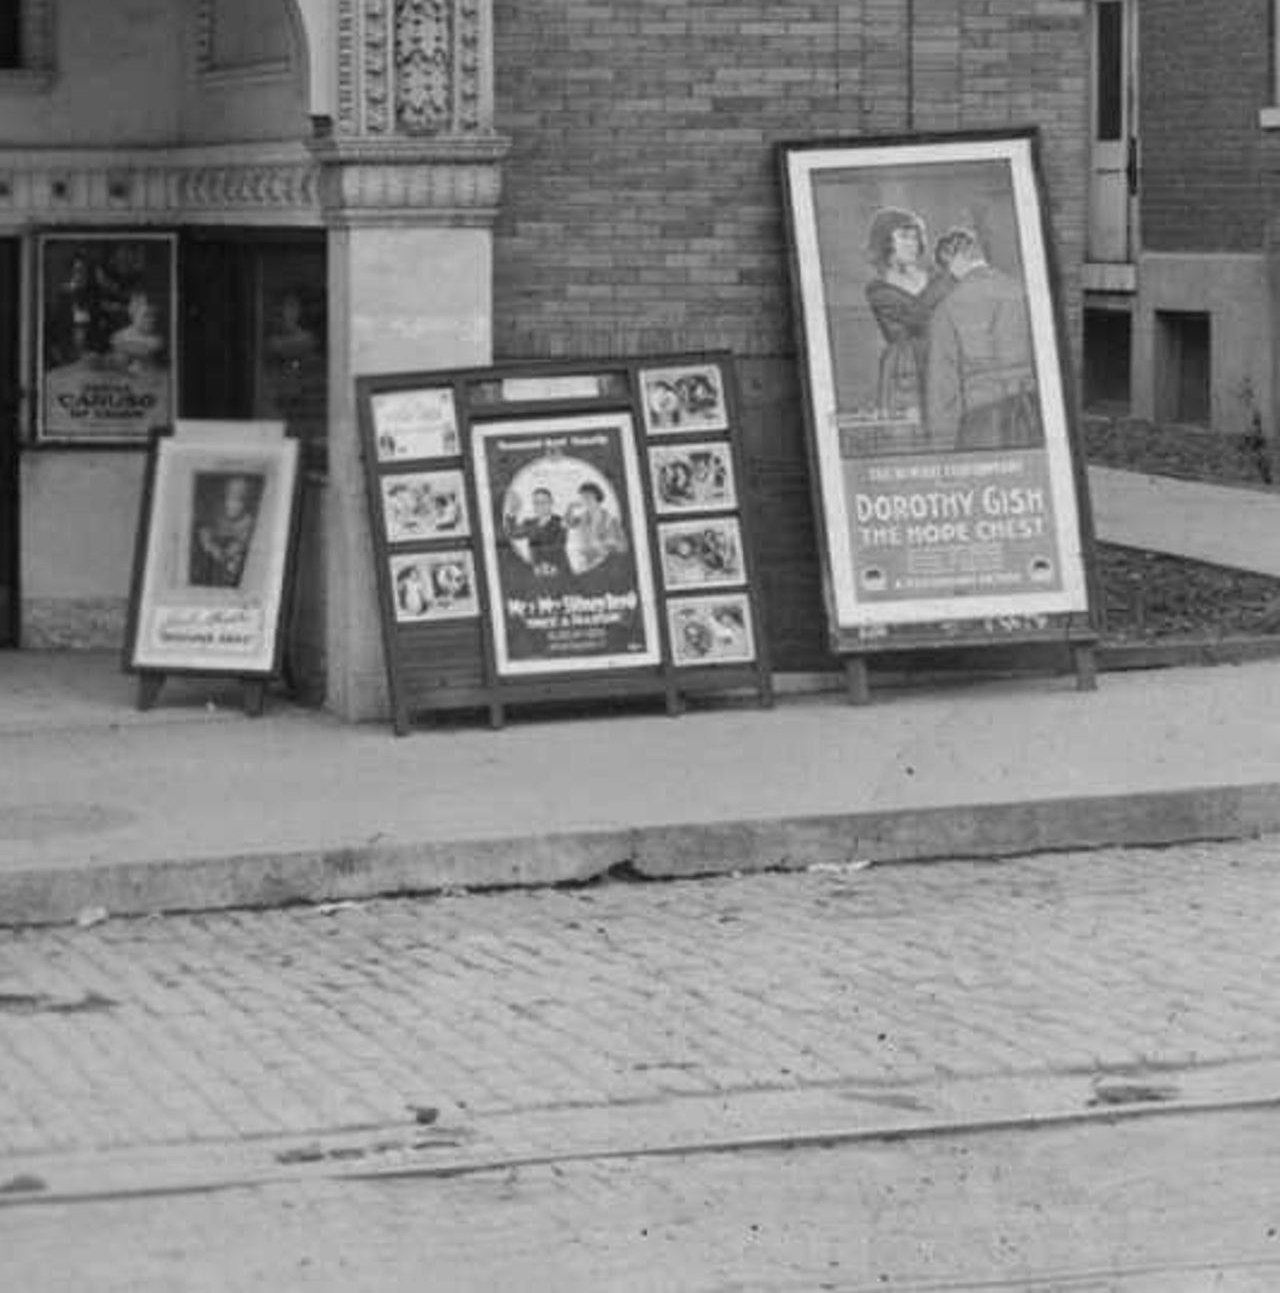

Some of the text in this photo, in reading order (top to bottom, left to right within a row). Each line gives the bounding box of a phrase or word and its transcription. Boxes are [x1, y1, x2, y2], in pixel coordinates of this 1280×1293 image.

[856, 485, 1042, 522] DOROTHY GISH
[860, 517, 1044, 546] THE HOPE CHEST
